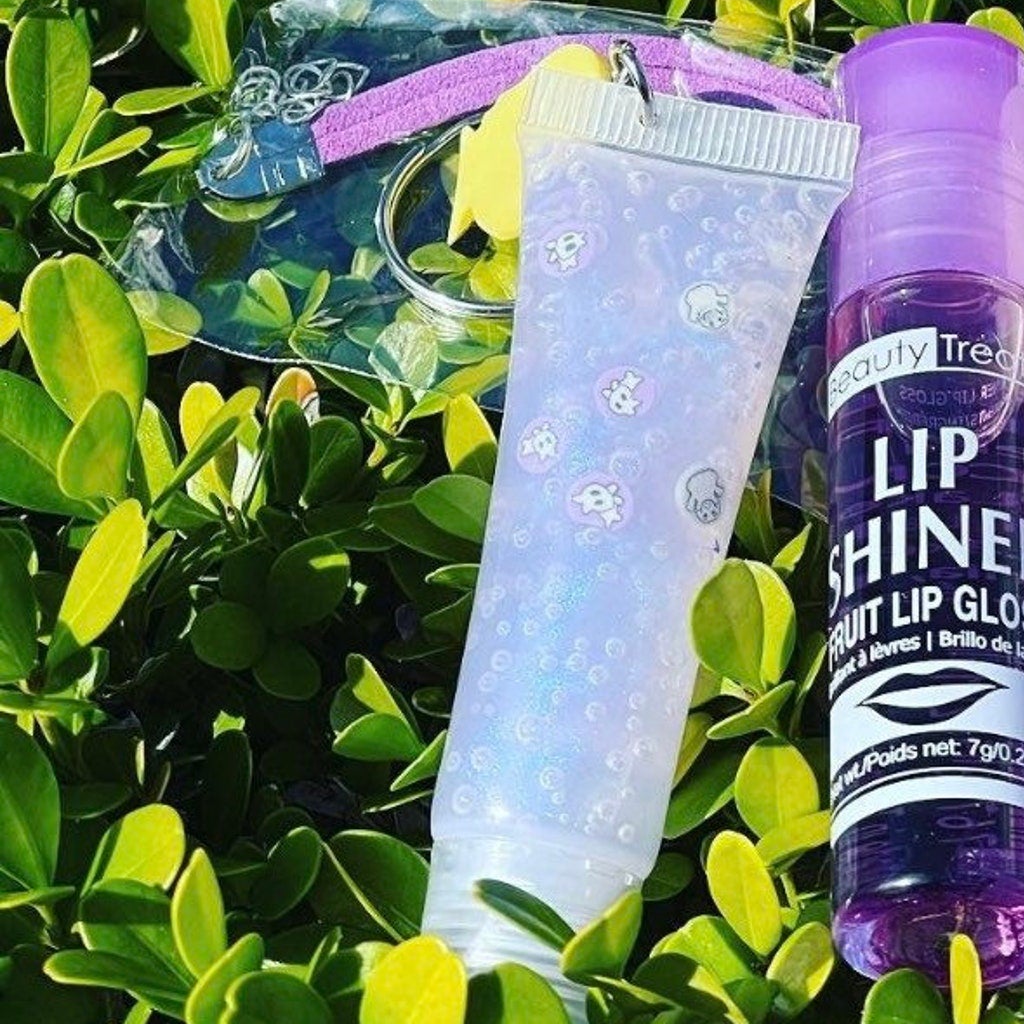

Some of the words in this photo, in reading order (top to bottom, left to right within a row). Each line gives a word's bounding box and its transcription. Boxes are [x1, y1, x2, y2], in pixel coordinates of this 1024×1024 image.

[829, 339, 929, 407] Beauty
[873, 426, 979, 502] LIP
[829, 596, 883, 672] FRUIT
[892, 586, 944, 629] LIP
[870, 635, 921, 662] lèvres
[939, 631, 987, 650] Brillo
[991, 635, 1013, 655] de
